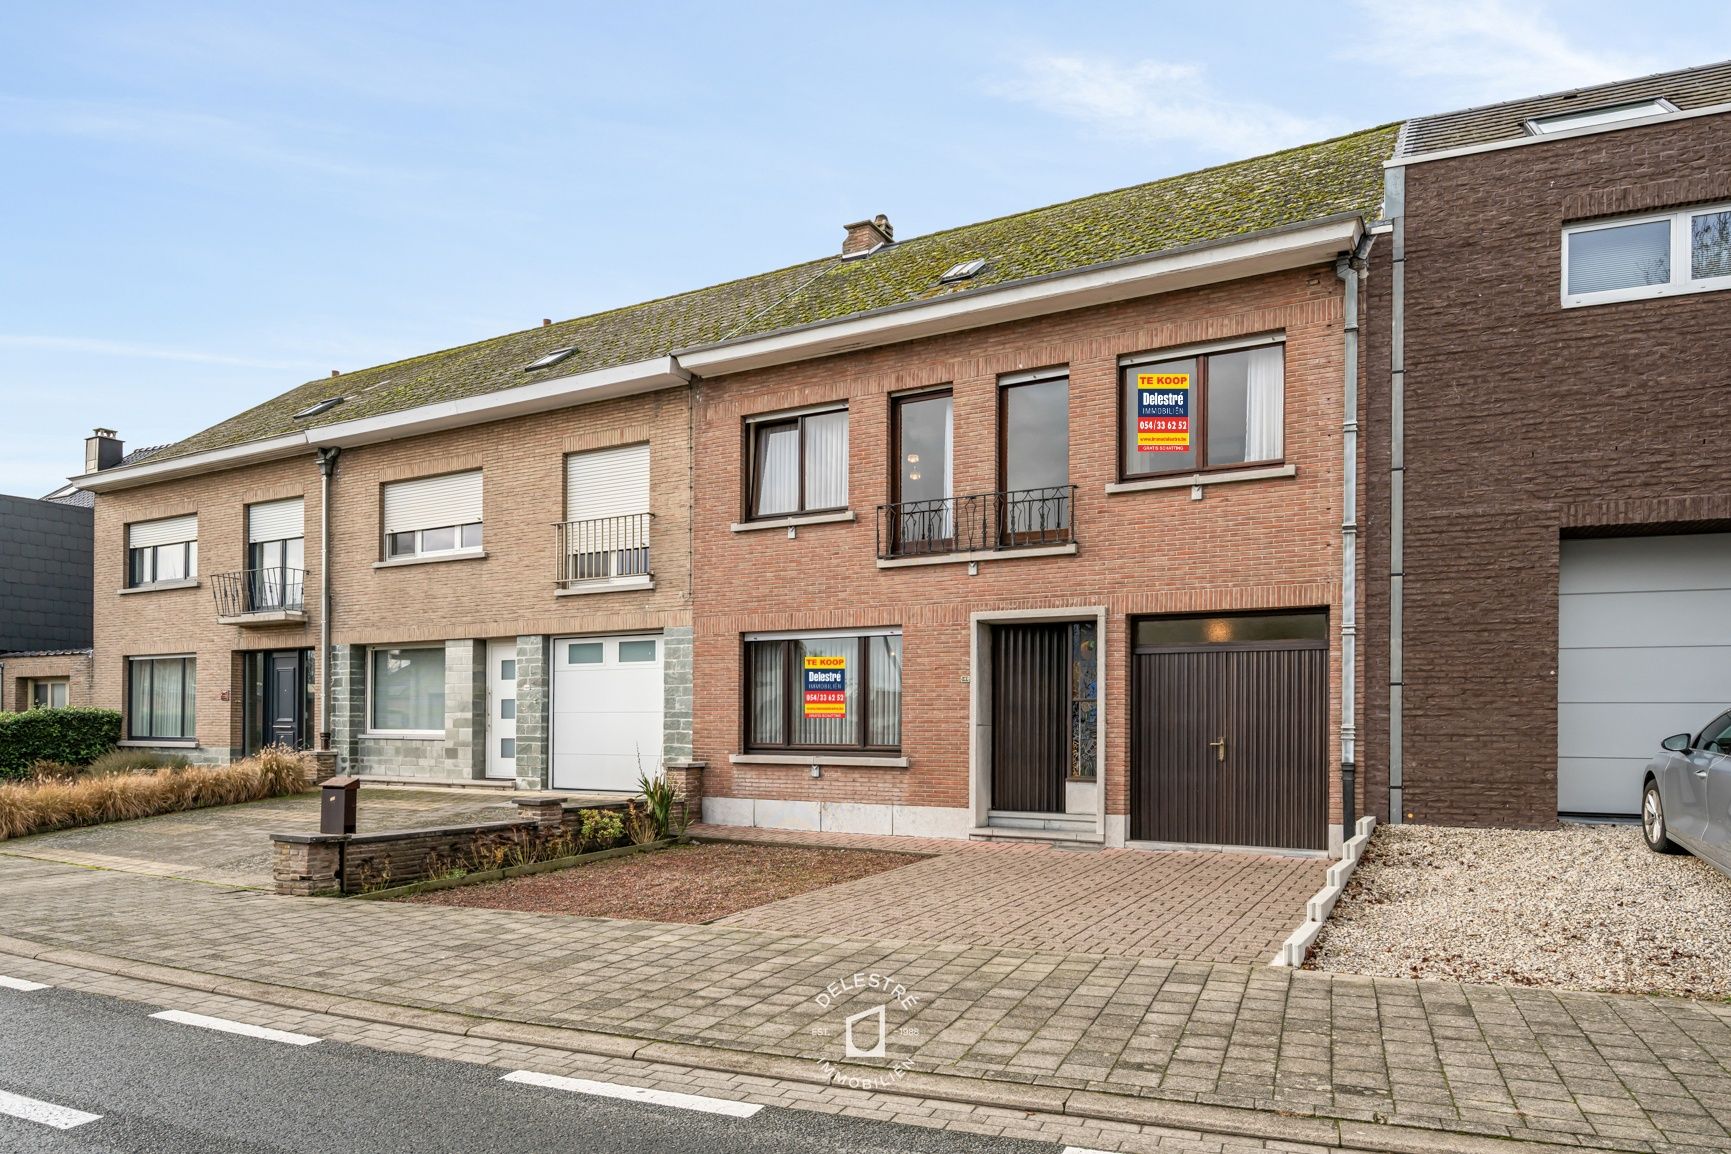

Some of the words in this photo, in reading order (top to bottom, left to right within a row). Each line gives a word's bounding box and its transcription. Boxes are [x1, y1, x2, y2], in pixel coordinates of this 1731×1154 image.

[1143, 392, 1183, 405] Delestré
[1140, 420, 1165, 430] 054/33
[1167, 421, 1176, 429] 62
[1178, 421, 1187, 429] 52
[808, 671, 841, 681] Delestré
